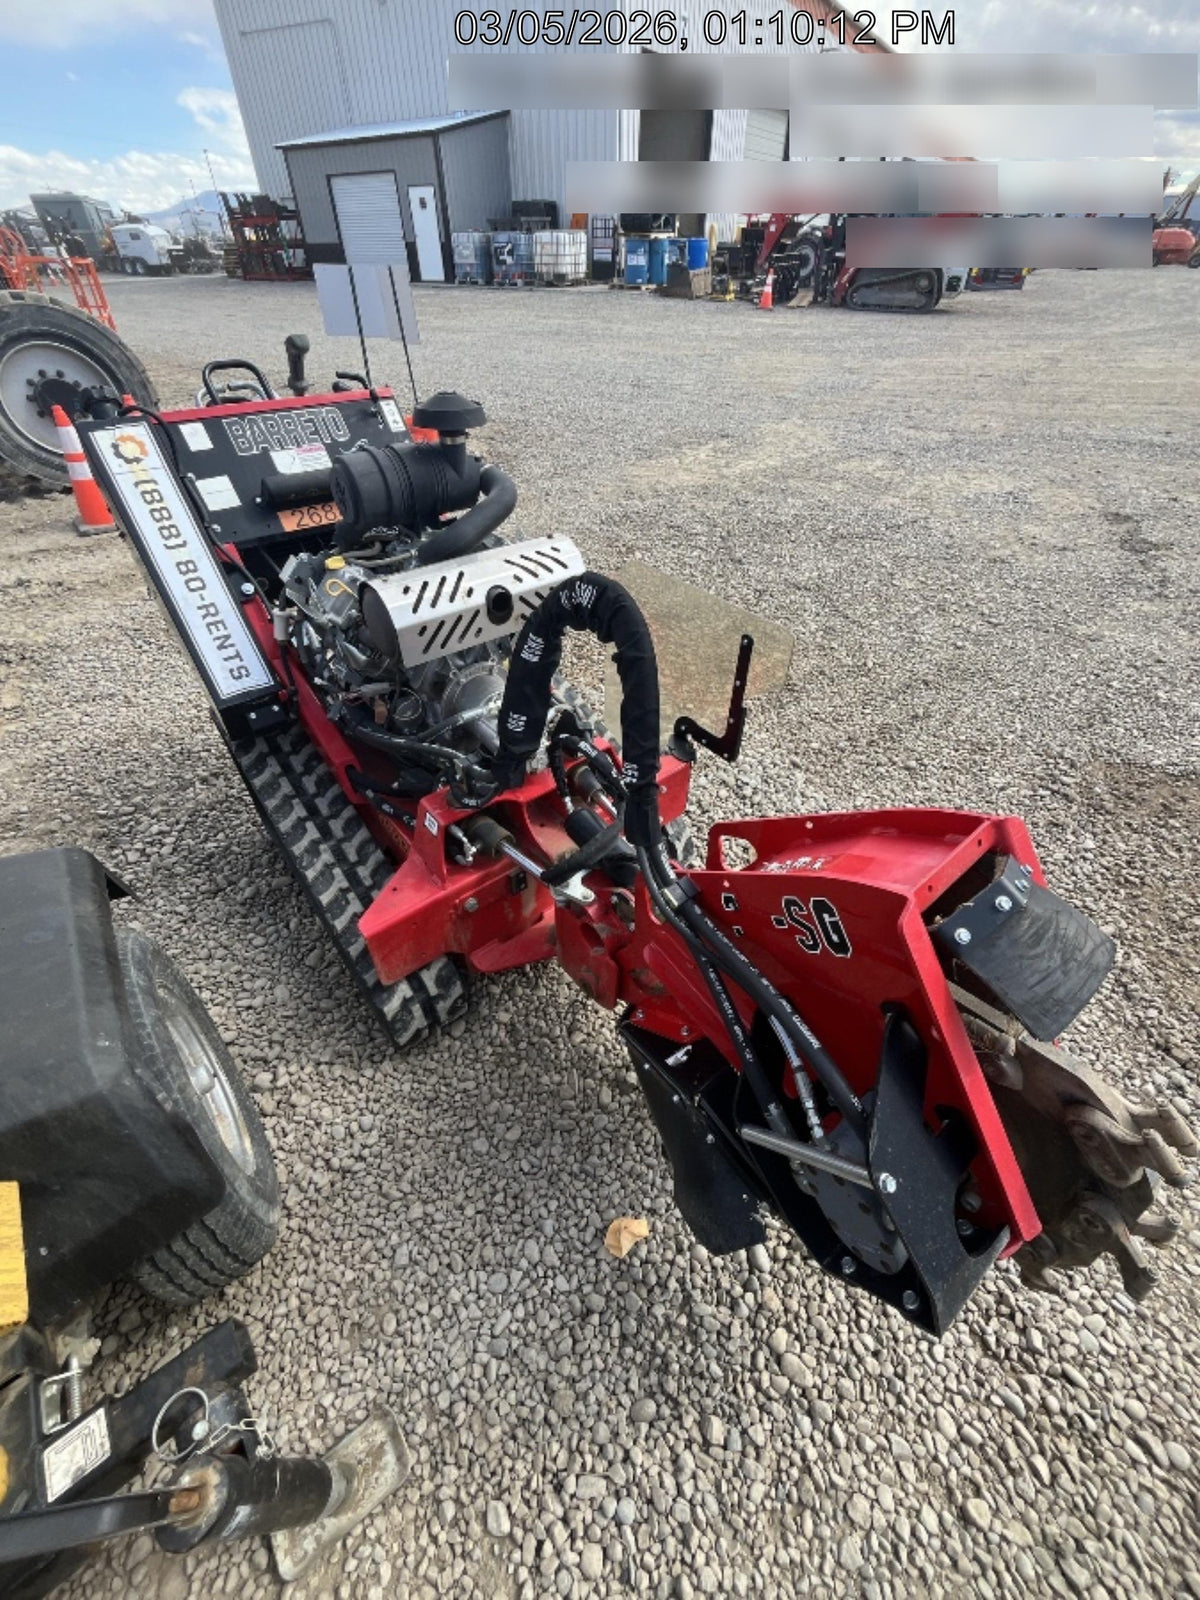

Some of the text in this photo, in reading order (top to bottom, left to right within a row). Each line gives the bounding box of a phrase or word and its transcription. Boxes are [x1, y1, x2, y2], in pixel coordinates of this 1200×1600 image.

[222, 406, 351, 456] BARRETO
[290, 503, 338, 529] 268
[134, 478, 250, 682] (888) 80-RENTS
